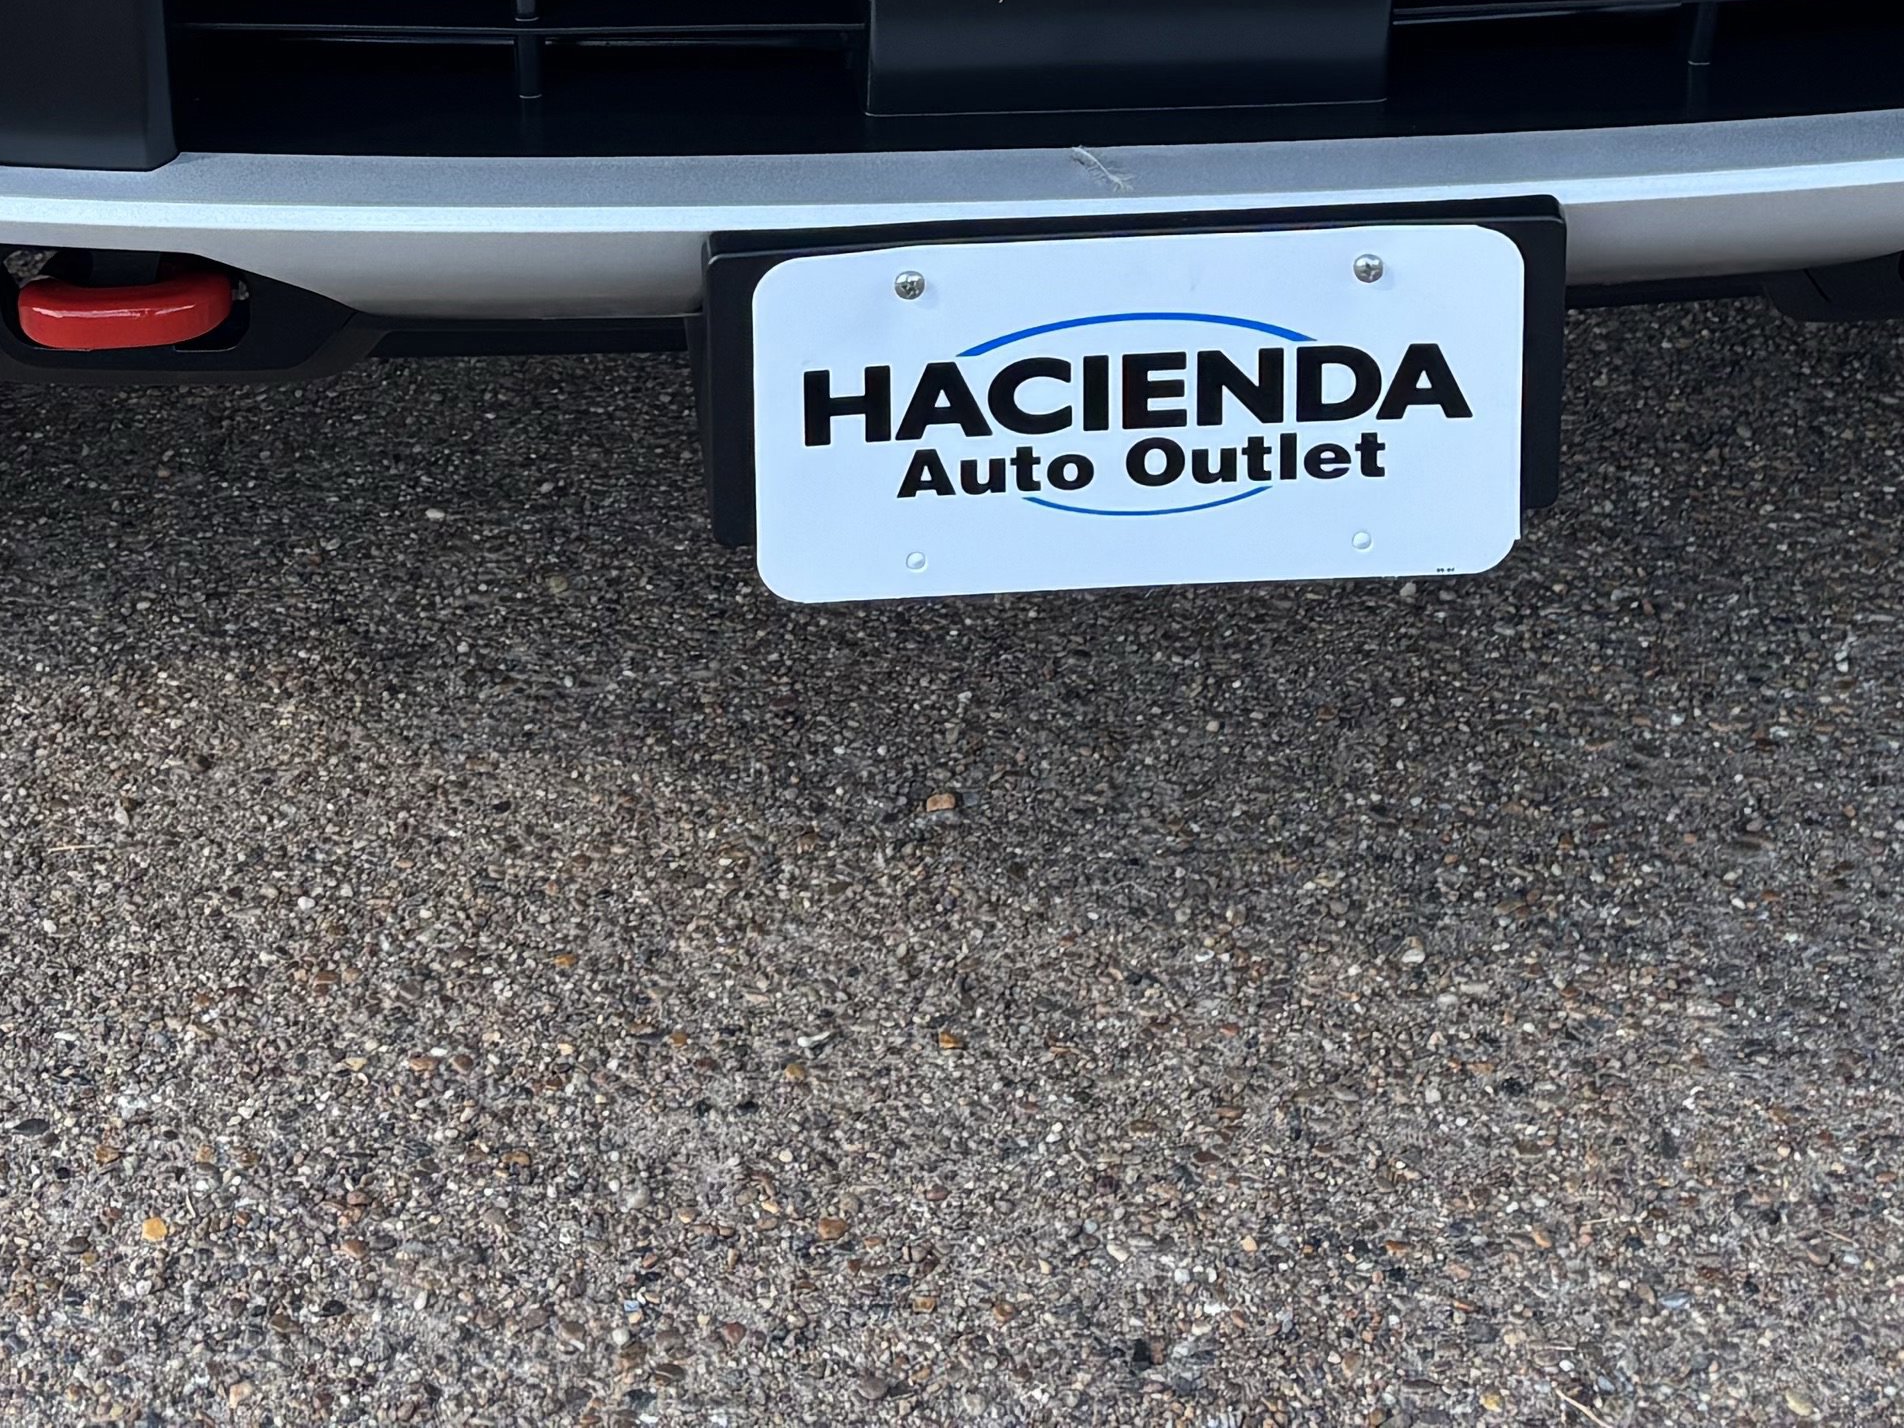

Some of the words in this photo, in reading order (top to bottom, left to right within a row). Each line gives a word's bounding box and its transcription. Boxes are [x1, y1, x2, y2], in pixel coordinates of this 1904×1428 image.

[803, 342, 1473, 447] HACIENDA
[896, 445, 1095, 499] Auto
[1126, 430, 1386, 487] Outlet
